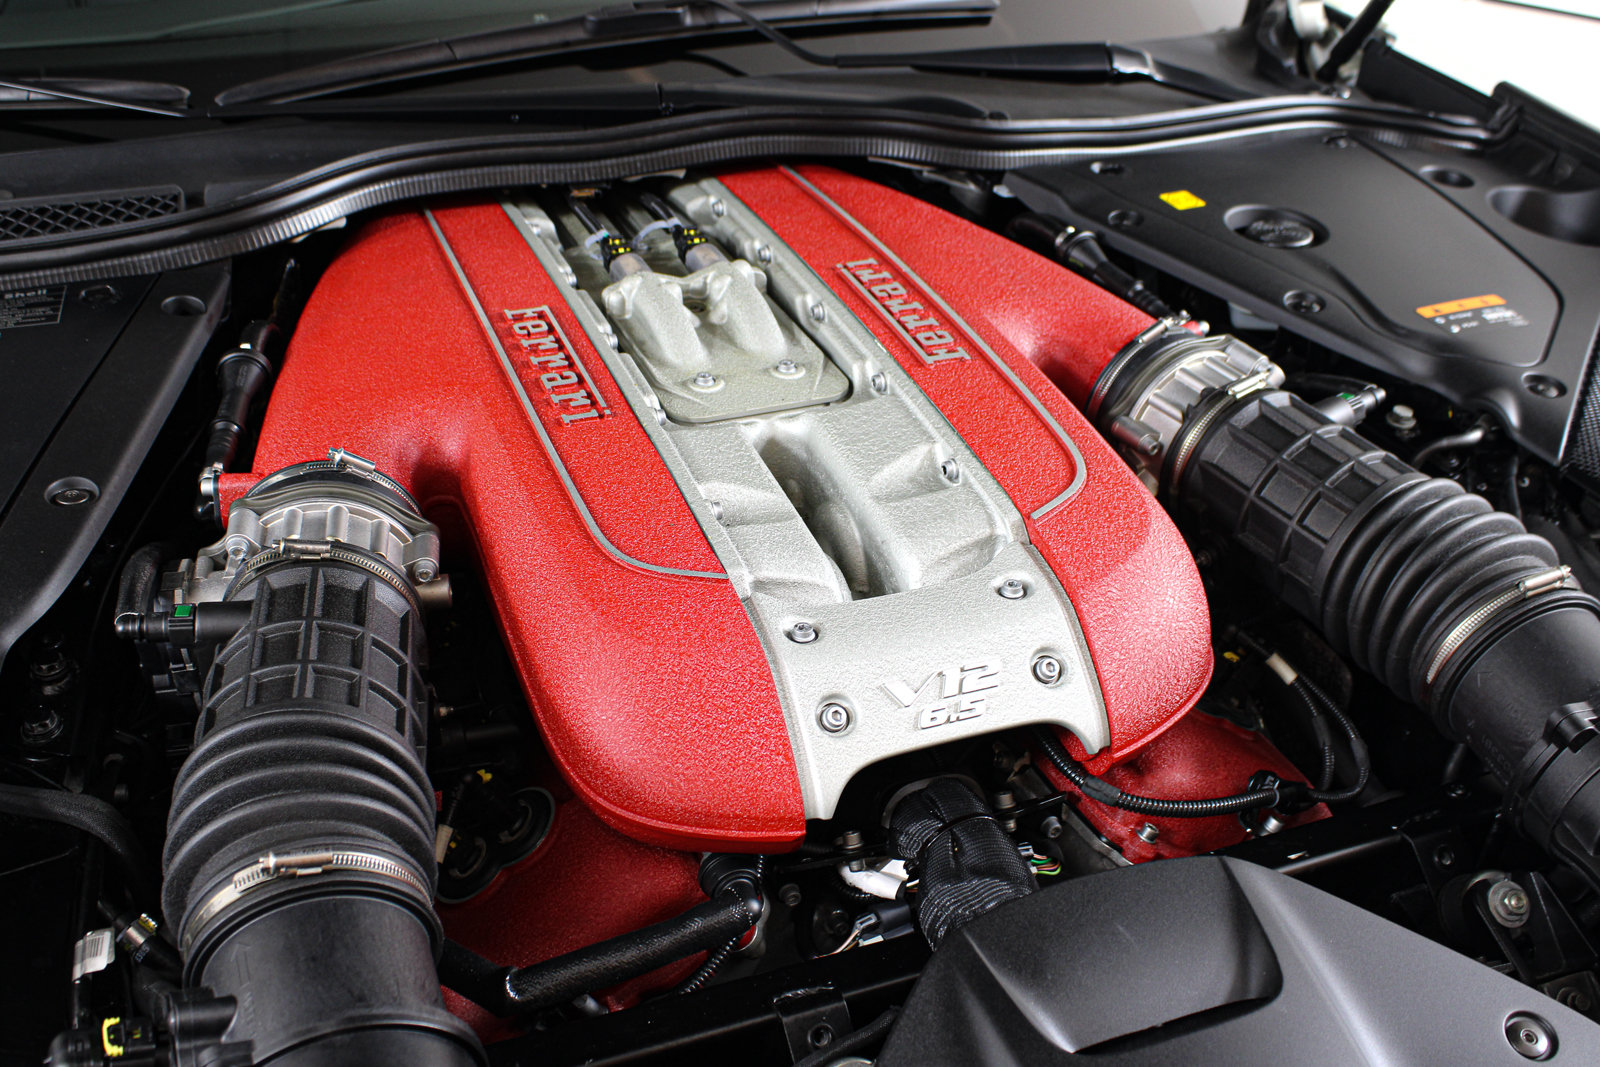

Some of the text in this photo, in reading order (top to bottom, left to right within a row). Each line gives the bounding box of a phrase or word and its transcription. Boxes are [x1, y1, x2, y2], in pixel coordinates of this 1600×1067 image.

[835, 257, 972, 365] Ferrari
[503, 304, 612, 425] Ferrari
[878, 658, 1002, 708] V12
[914, 696, 987, 731] 6.5
